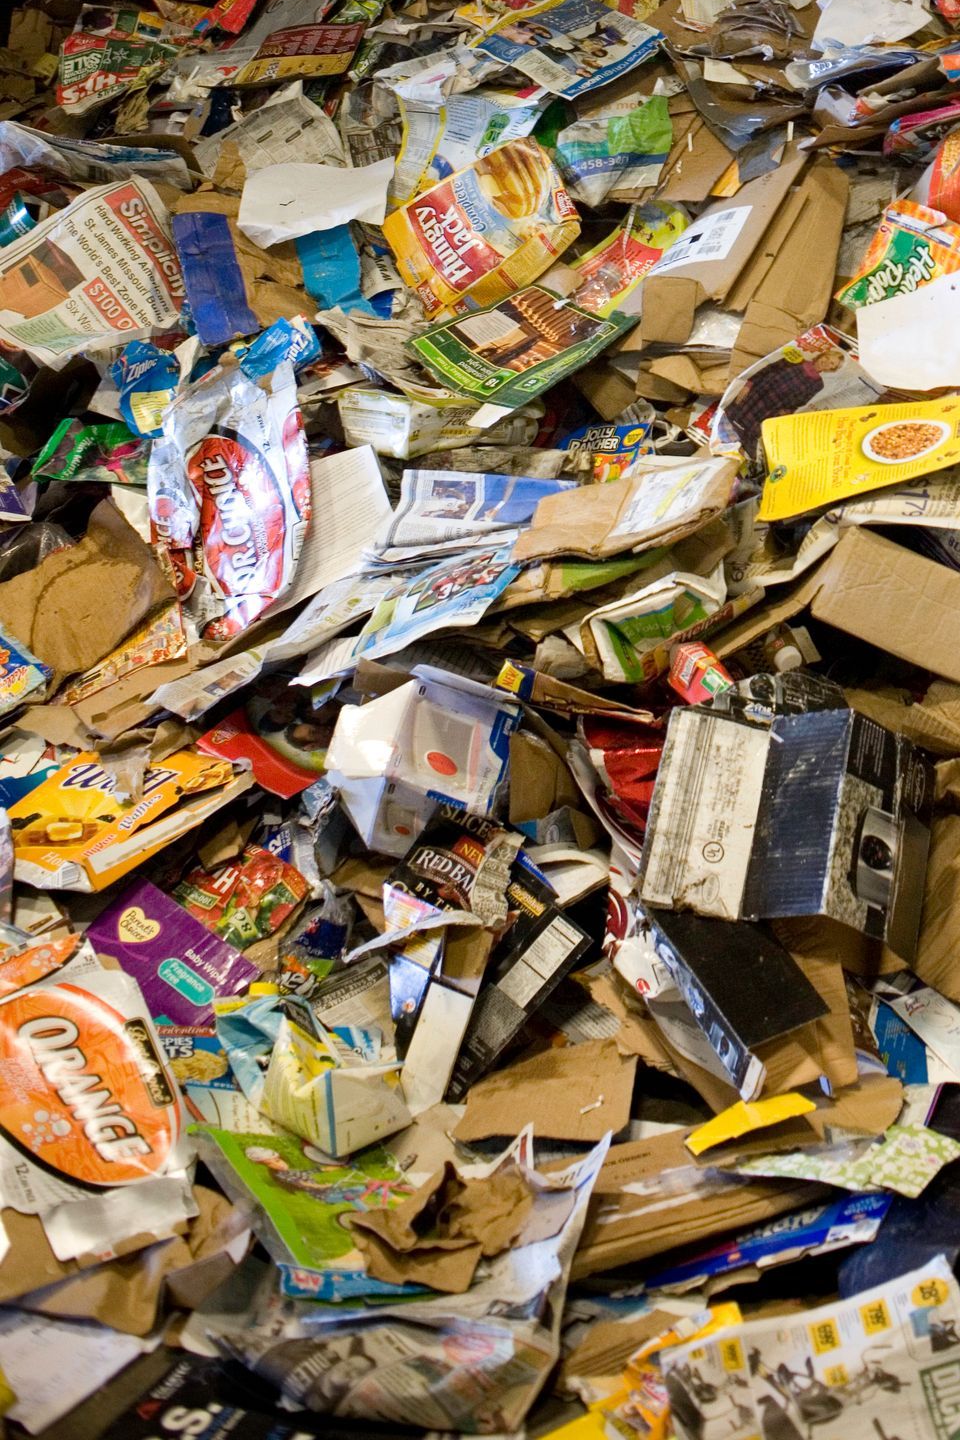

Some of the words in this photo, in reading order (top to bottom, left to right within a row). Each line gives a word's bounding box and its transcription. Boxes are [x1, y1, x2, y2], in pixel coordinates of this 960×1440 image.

[63, 52, 103, 71] SALE
[61, 72, 117, 105] HL'S
[454, 181, 487, 234] Complete
[119, 197, 188, 298] Simplicity
[414, 206, 473, 284] Hungry
[439, 206, 487, 258] Jack
[64, 219, 79, 239] The
[78, 237, 102, 268] World's
[99, 266, 117, 288] Best
[116, 285, 138, 312] Zone
[135, 307, 153, 330] Hea
[83, 218, 96, 234] St.
[92, 231, 115, 258] James
[114, 259, 146, 298] Missouri
[144, 295, 164, 323] Build
[93, 204, 114, 228] Hard
[107, 221, 141, 263] Working
[139, 260, 171, 314] Americans
[64, 299, 78, 315] Six
[87, 282, 120, 321] $100
[283, 334, 309, 363] Zipl
[124, 358, 158, 383] Ziploc
[569, 437, 619, 453] RANCHER
[582, 426, 613, 442] JOLLY
[117, 792, 163, 832] Waffles
[416, 849, 453, 878] RED
[414, 882, 434, 897] BY
[120, 919, 149, 941] Choice
[125, 910, 155, 935] Parent's
[161, 969, 180, 985] Free
[170, 961, 206, 992] Fragrance
[184, 948, 204, 969] Baby
[202, 961, 228, 986] Wipes
[17, 1014, 156, 1165] ORANGE
[14, 1162, 29, 1176] 12
